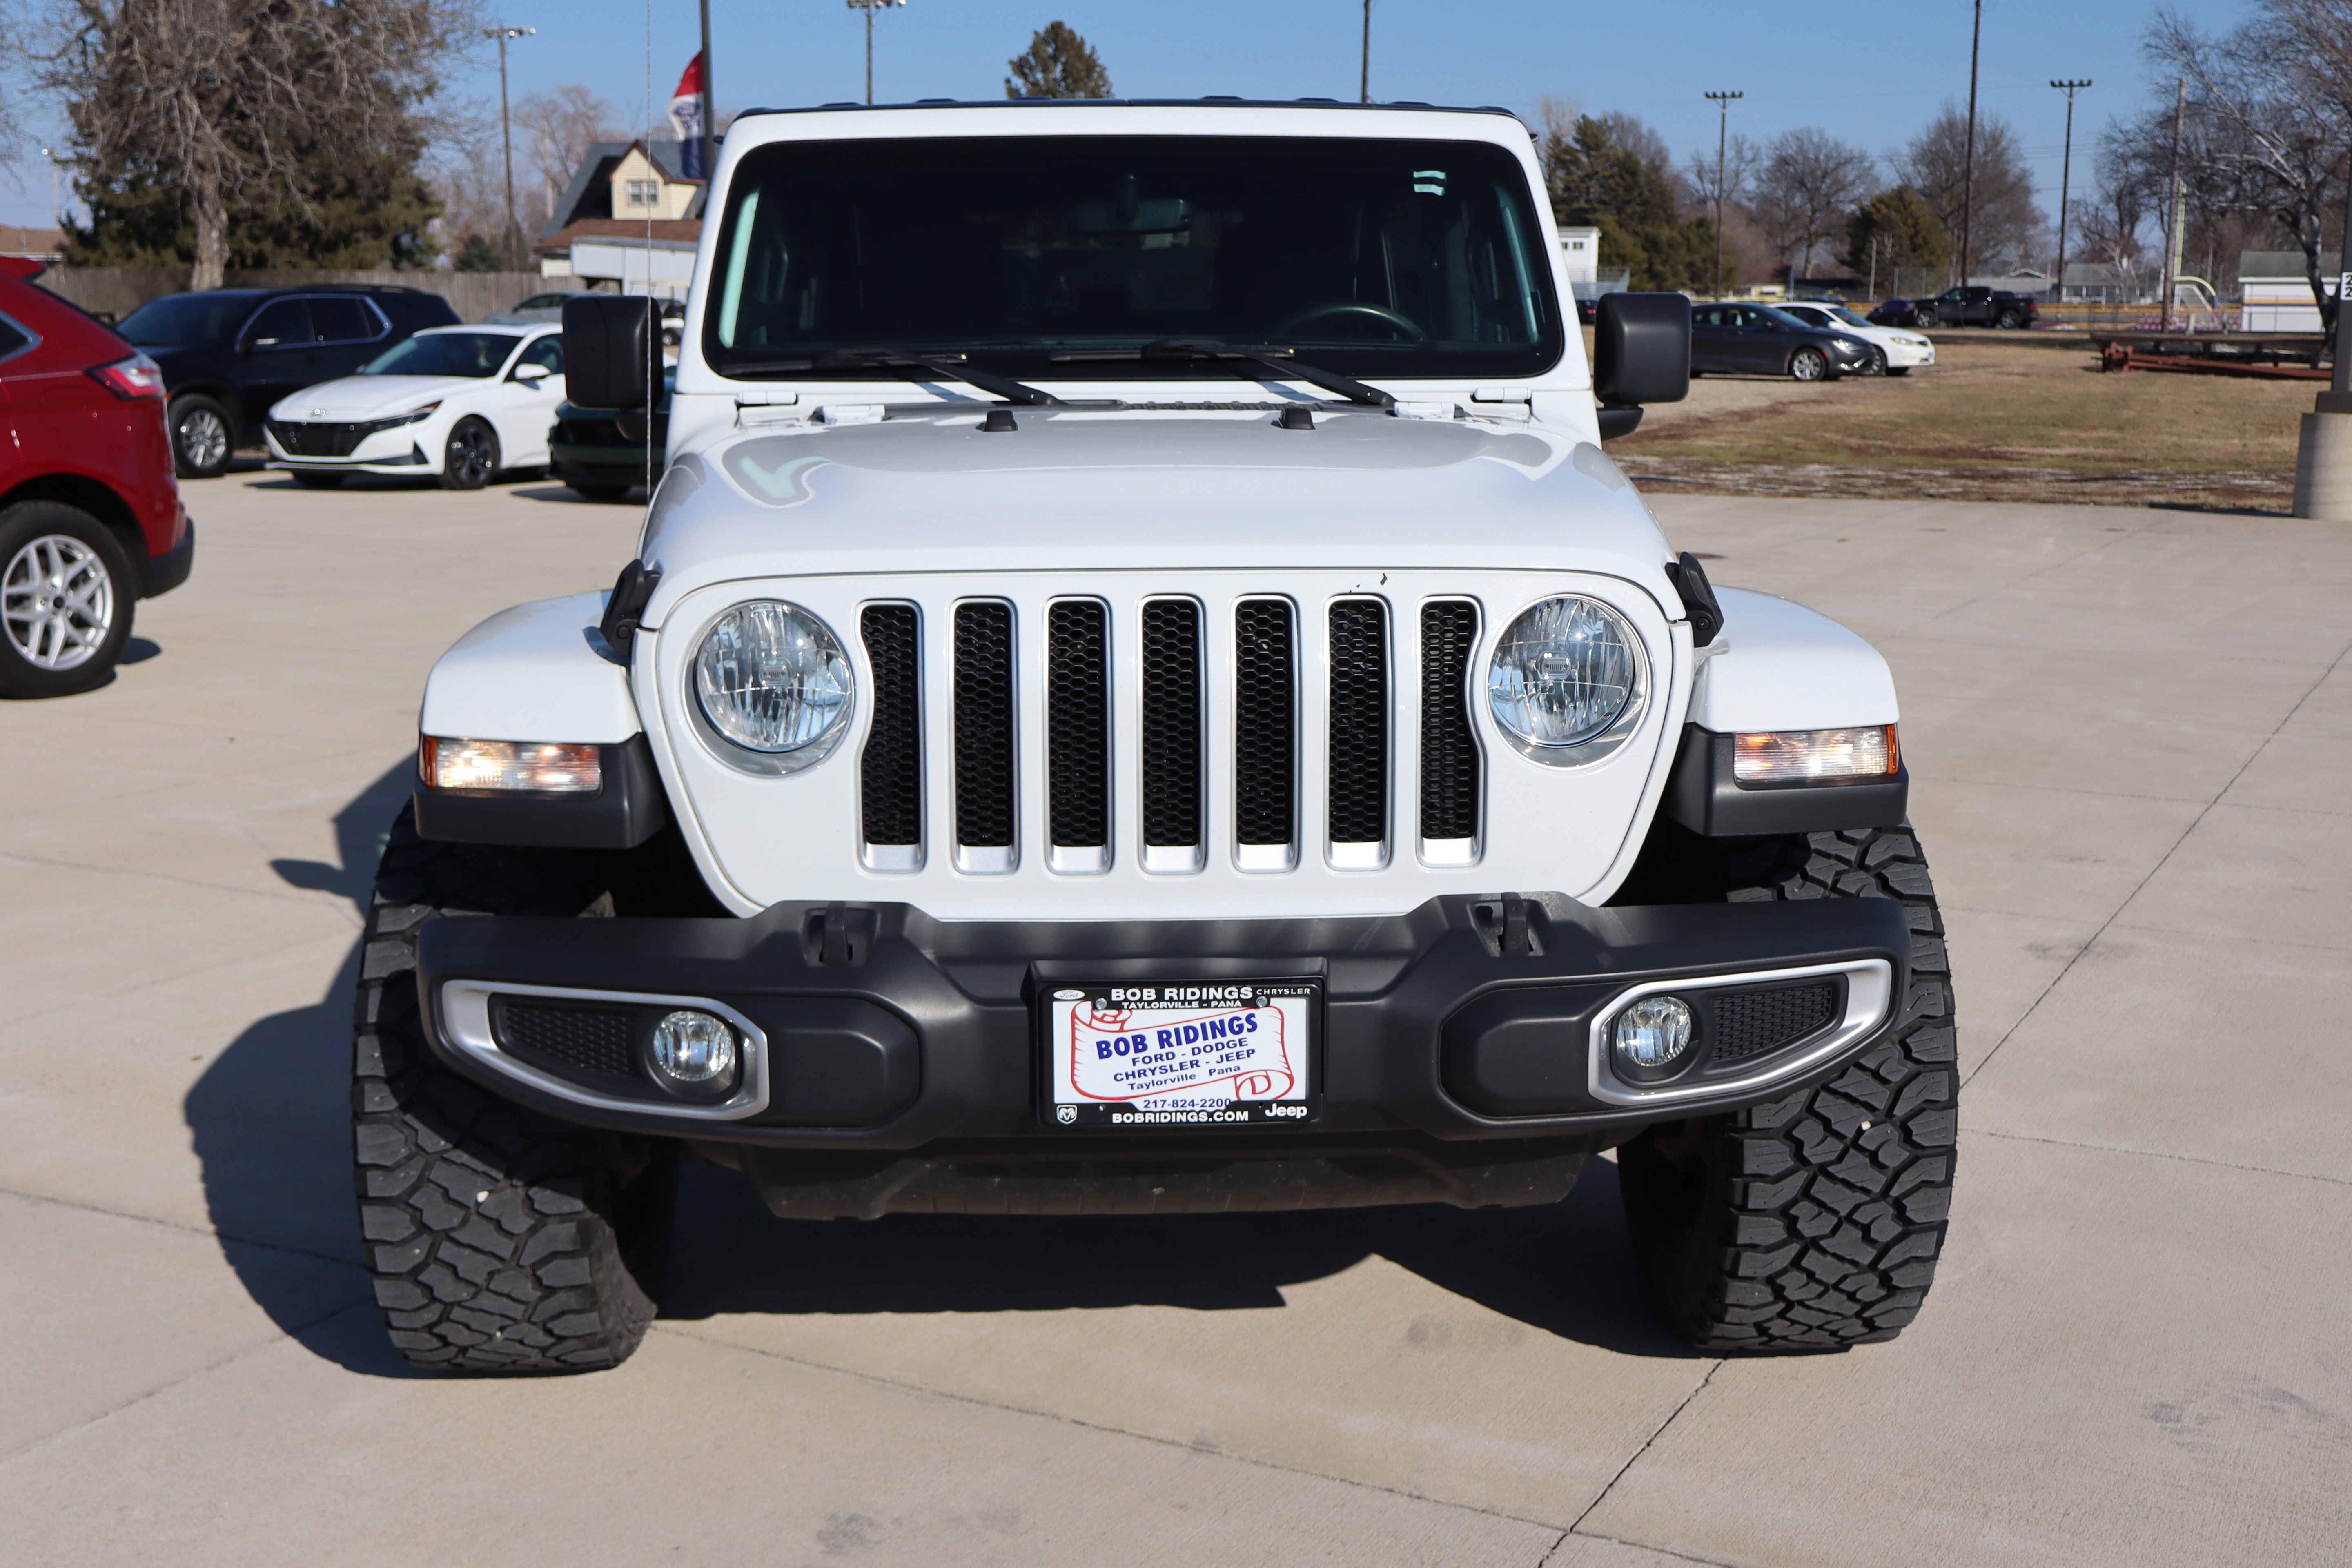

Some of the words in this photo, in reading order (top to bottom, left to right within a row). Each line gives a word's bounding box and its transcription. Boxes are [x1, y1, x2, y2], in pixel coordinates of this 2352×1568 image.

[1111, 988, 1156, 1001] BOB
[1164, 987, 1253, 1000] RIDINGS
[1121, 1001, 1199, 1009] TAYLORVILLE
[1096, 1034, 1148, 1060] BOB
[1157, 1013, 1258, 1049] RIDINGS
[1131, 1051, 1176, 1067] FORD
[1191, 1037, 1249, 1056] DODGE
[1113, 1059, 1201, 1082] CHRYSLER
[1216, 1048, 1256, 1064] JEEP
[1128, 1074, 1196, 1091] Taylorville
[1209, 1065, 1241, 1076] Pana
[1143, 1098, 1231, 1108] 217-824-2200
[1265, 1102, 1308, 1119] Jeep
[1112, 1111, 1249, 1123] BOBRIDINGS.COM
